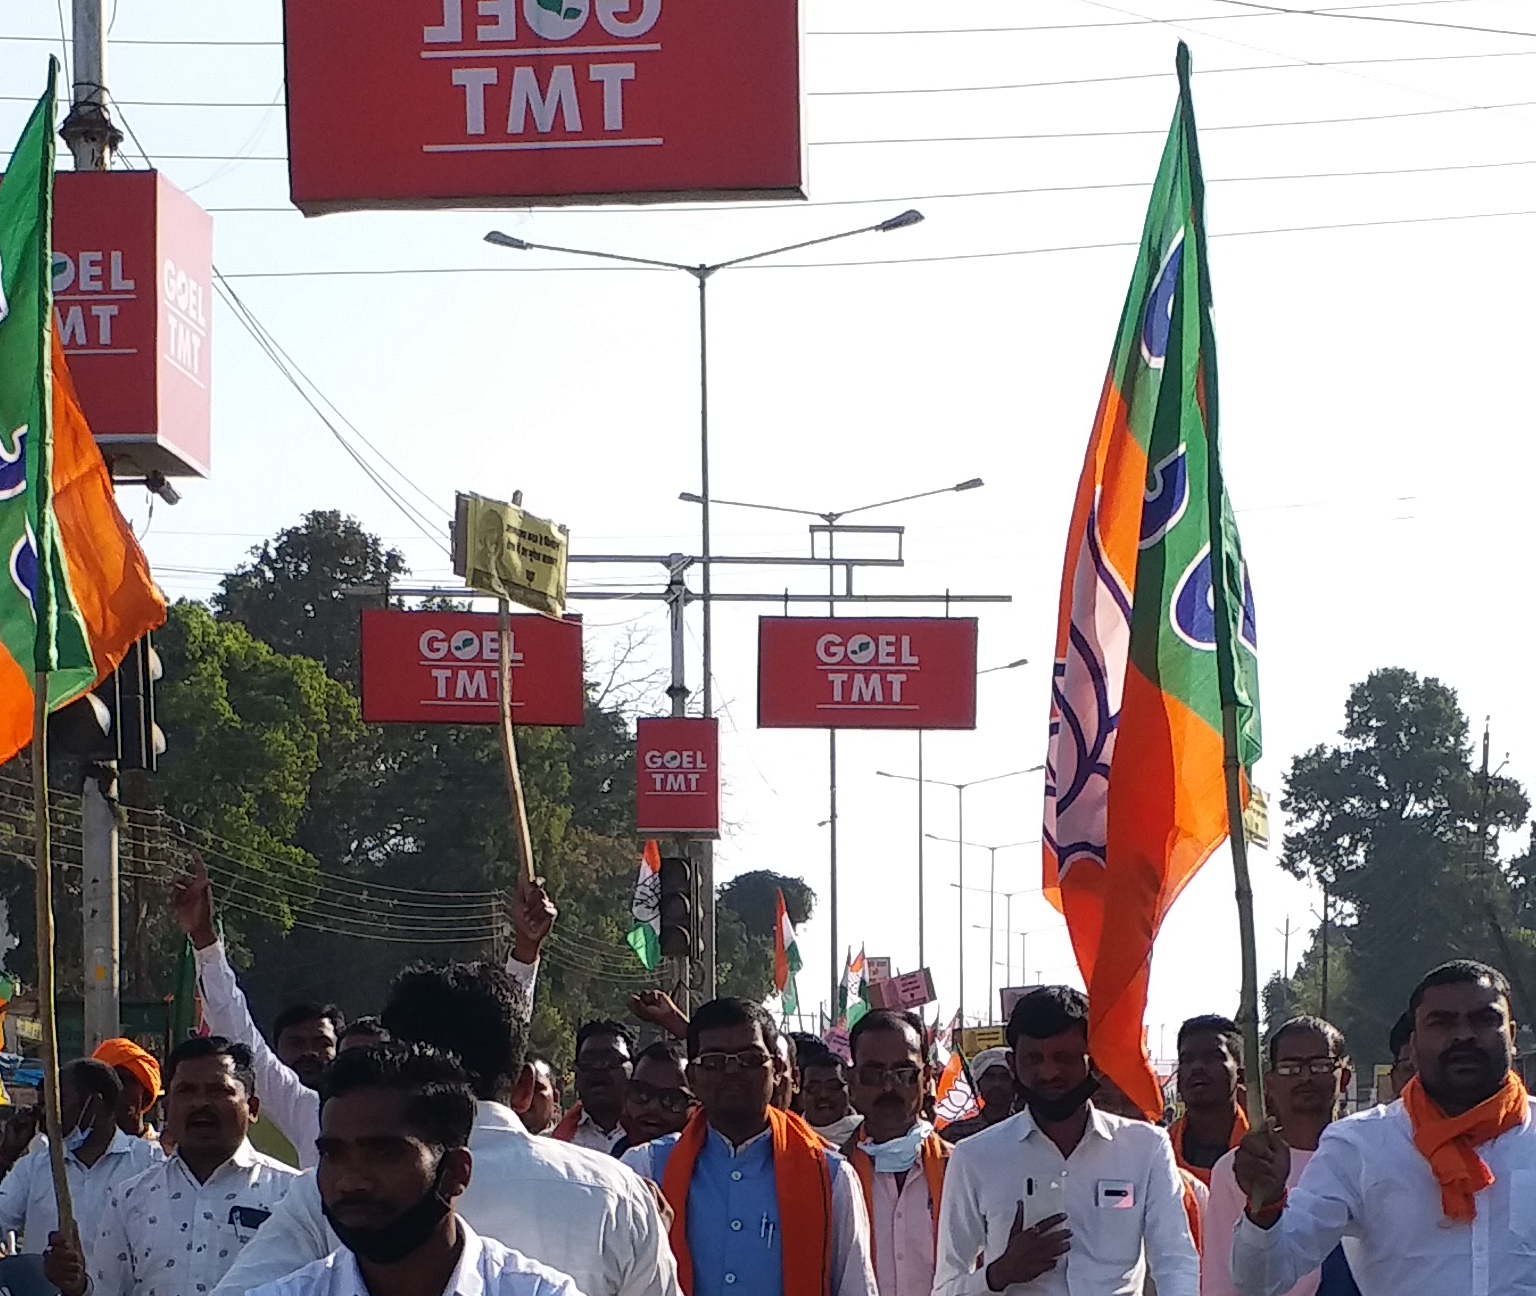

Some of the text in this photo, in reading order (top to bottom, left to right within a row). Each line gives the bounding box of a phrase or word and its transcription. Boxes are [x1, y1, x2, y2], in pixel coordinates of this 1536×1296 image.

[52, 250, 136, 292] OEL
[164, 258, 206, 328] GOEL
[54, 304, 119, 346] MT
[167, 313, 202, 375] TMT
[418, 628, 524, 663] GOEL
[815, 633, 919, 666] GOEL
[827, 673, 906, 702] TMT
[644, 750, 707, 771] GOEL
[650, 773, 701, 793] TMT
